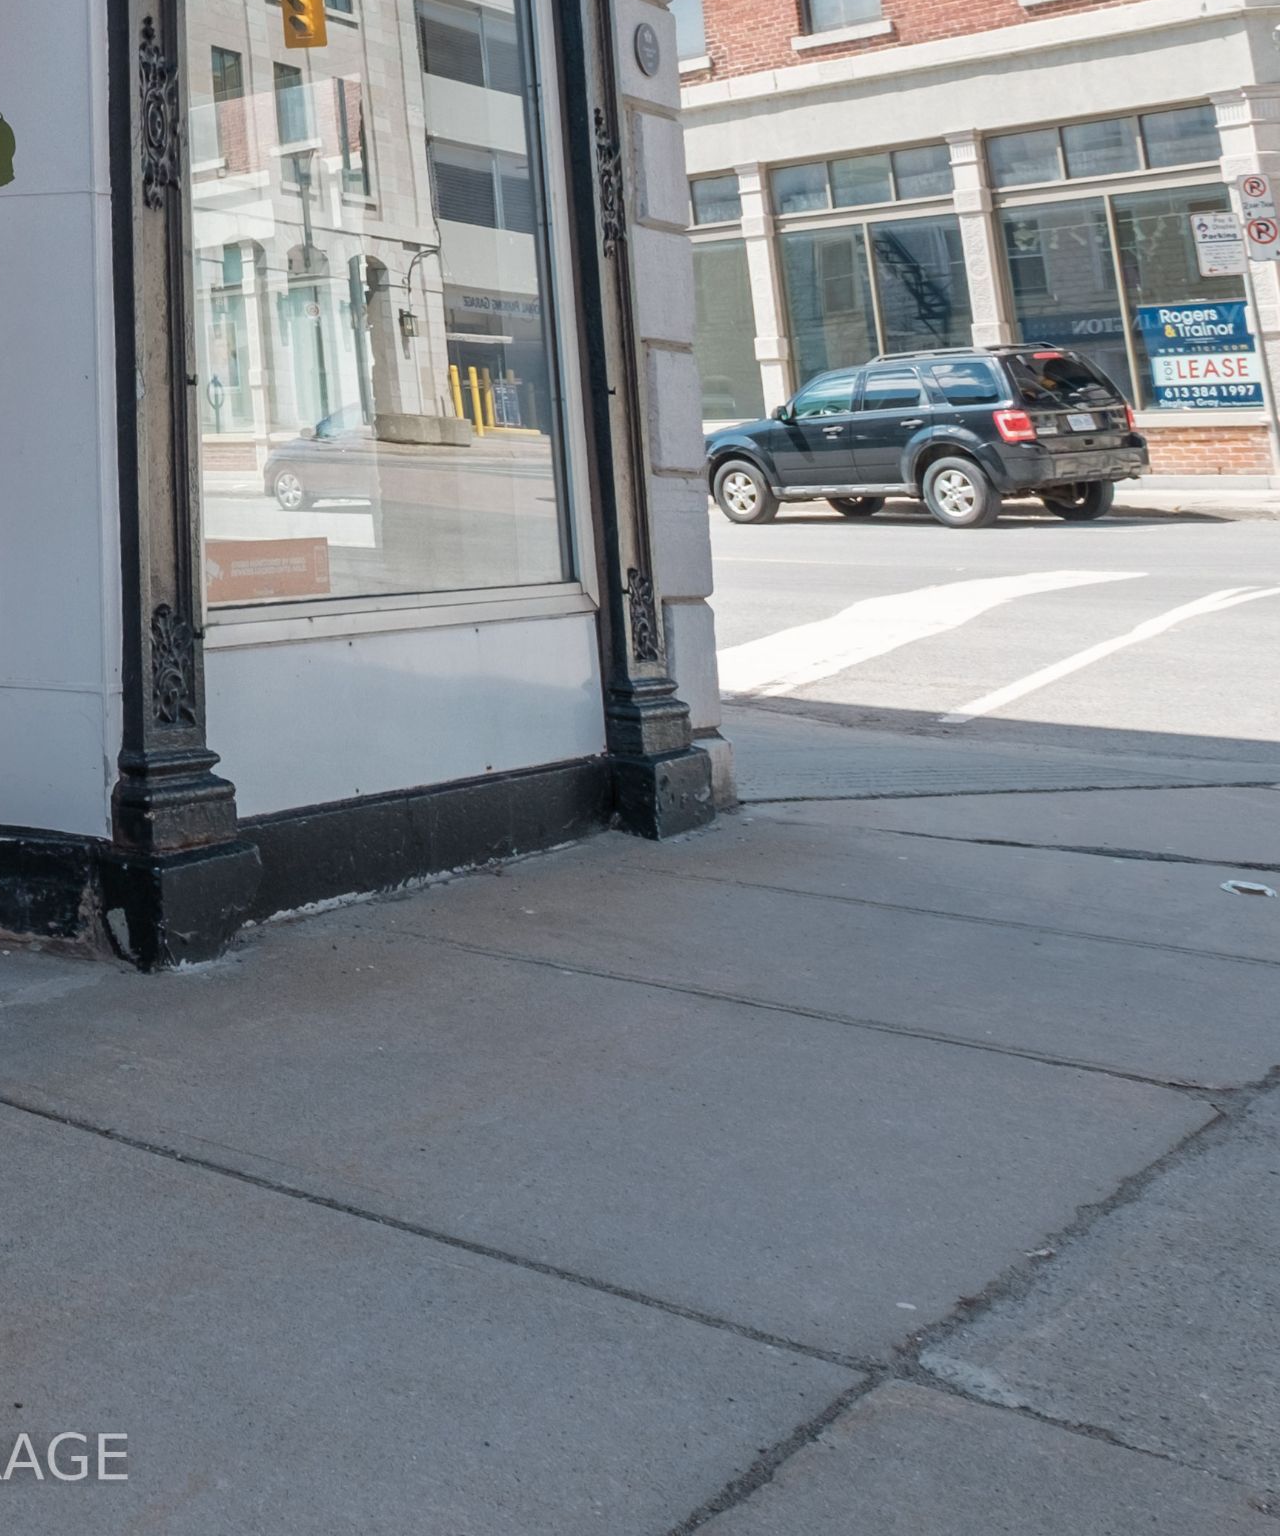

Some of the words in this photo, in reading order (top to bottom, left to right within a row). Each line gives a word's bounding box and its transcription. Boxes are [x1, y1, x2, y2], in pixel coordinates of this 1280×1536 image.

[1201, 232, 1238, 240] Parking
[1159, 309, 1218, 325] Rogers
[1162, 360, 1174, 381] FOR
[1176, 358, 1249, 379] LEASE
[1164, 387, 1190, 398] 613
[1192, 386, 1218, 397] 384
[1220, 385, 1255, 396] 1997
